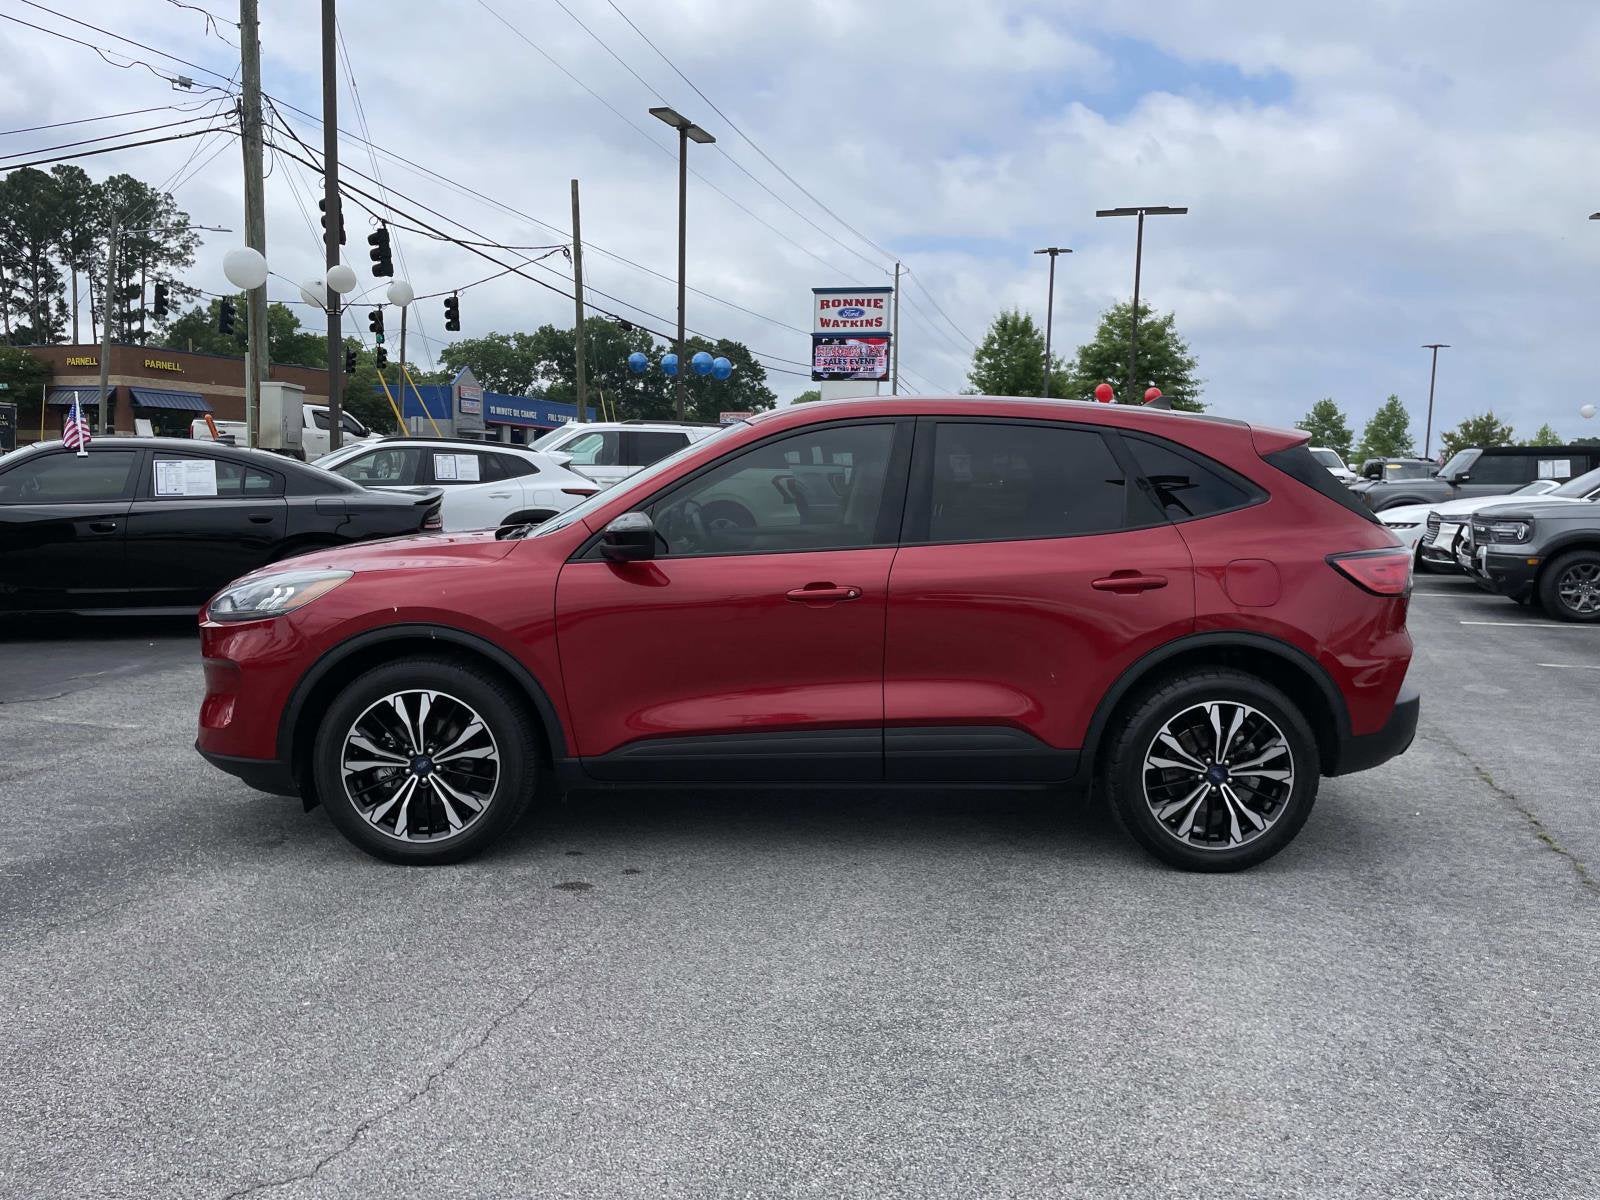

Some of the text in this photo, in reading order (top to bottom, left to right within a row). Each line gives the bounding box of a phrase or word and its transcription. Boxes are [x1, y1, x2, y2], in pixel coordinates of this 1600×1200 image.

[820, 298, 884, 310] RONNIE
[820, 317, 883, 328] WATKINS
[66, 357, 98, 366] PARNELL
[144, 359, 183, 372] PARNELL
[490, 405, 496, 415] 10
[496, 406, 513, 417] MINUTE
[520, 409, 537, 420] CHANGE
